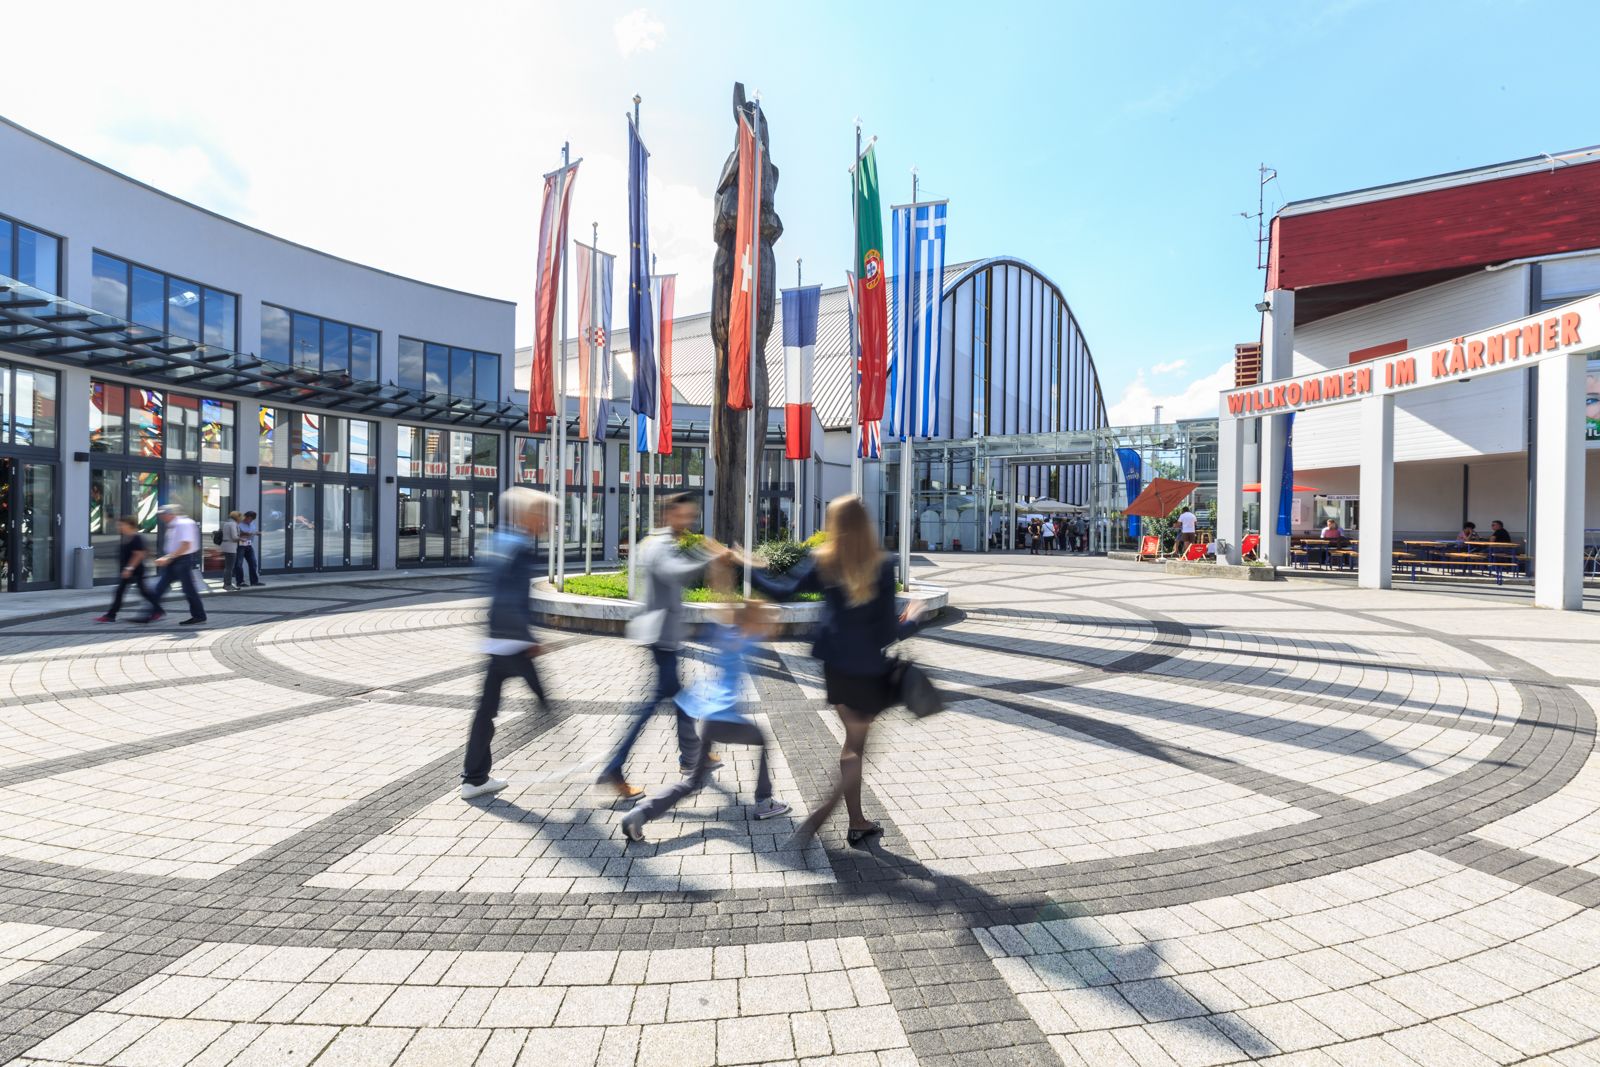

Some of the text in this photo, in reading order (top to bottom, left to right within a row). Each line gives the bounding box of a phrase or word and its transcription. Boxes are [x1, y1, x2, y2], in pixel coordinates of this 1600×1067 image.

[1227, 311, 1581, 415] WILLKOMMEN IM KÄRNTNER
